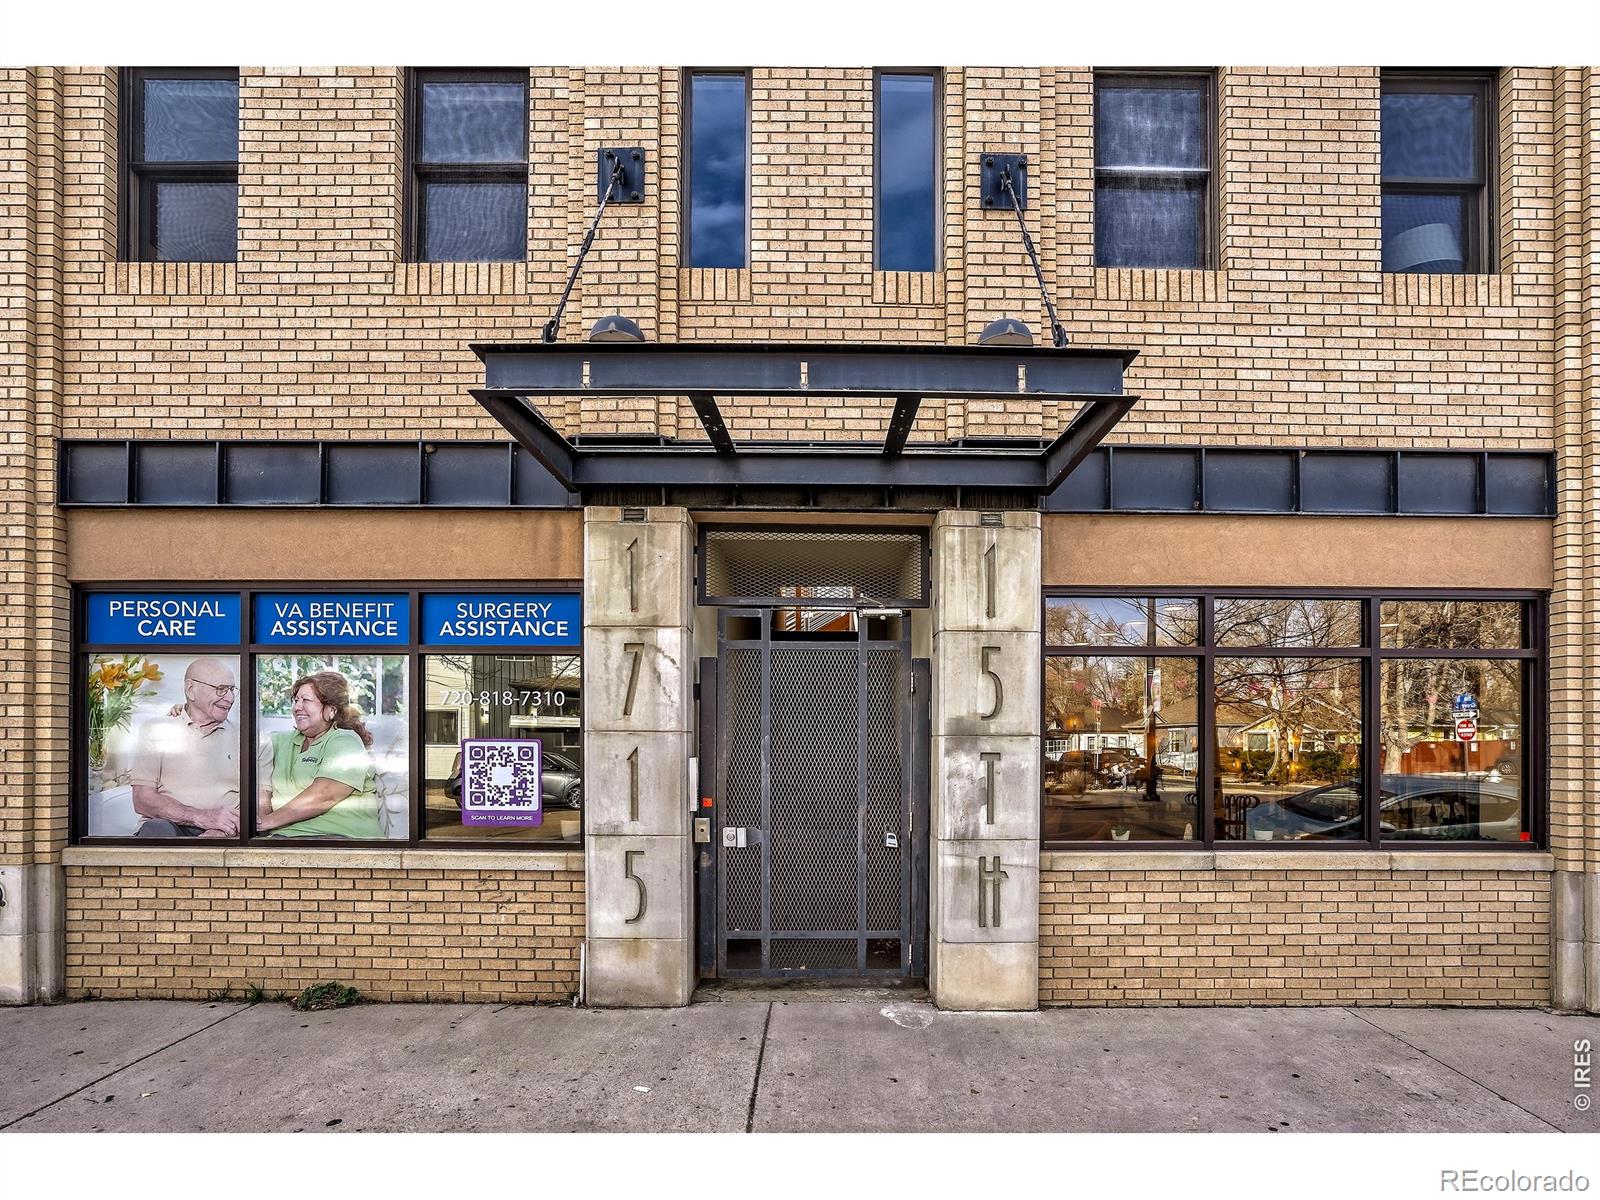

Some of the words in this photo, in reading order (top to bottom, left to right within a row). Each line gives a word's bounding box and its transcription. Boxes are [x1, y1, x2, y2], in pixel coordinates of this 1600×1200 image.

[109, 600, 226, 617] PERSONAL
[275, 602, 302, 618] VA
[310, 603, 395, 618] BENEFIT
[456, 602, 552, 618] SURGERY
[137, 619, 197, 637] CARE
[270, 620, 399, 637] ASSISTANCE
[439, 621, 569, 637] ASSISTANCE
[439, 690, 566, 706] 720-818-7310
